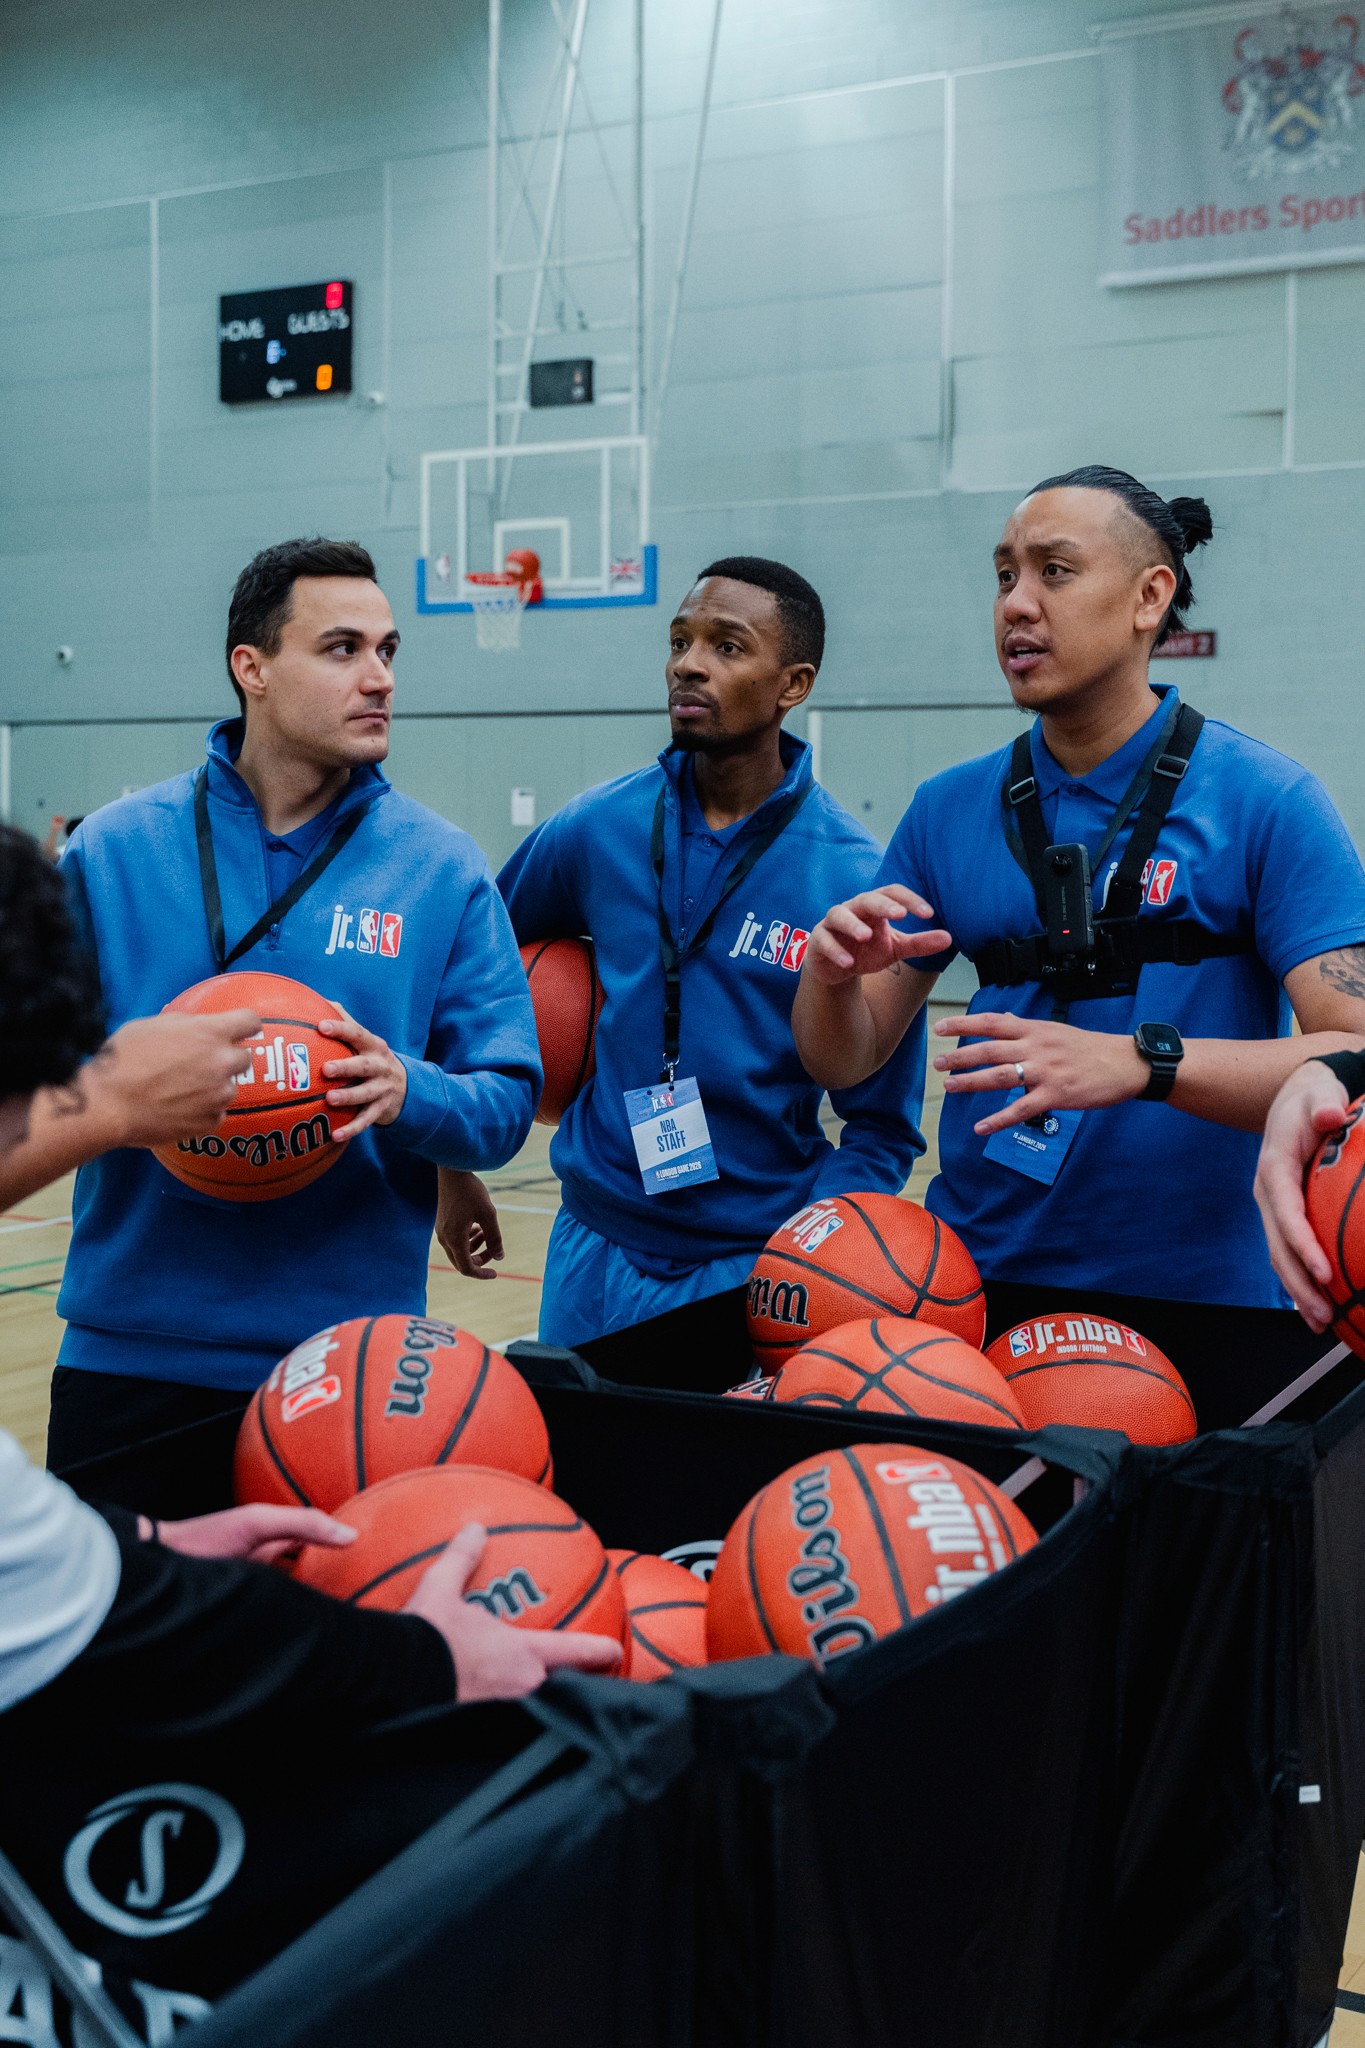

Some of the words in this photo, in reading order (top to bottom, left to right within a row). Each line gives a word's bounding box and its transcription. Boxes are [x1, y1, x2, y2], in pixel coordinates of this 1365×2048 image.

[1124, 204, 1271, 246] Saddlers
[325, 904, 355, 955] jr.
[728, 911, 763, 958] jr.
[656, 1130, 687, 1153] STAFF
[660, 1118, 677, 1133] NBA
